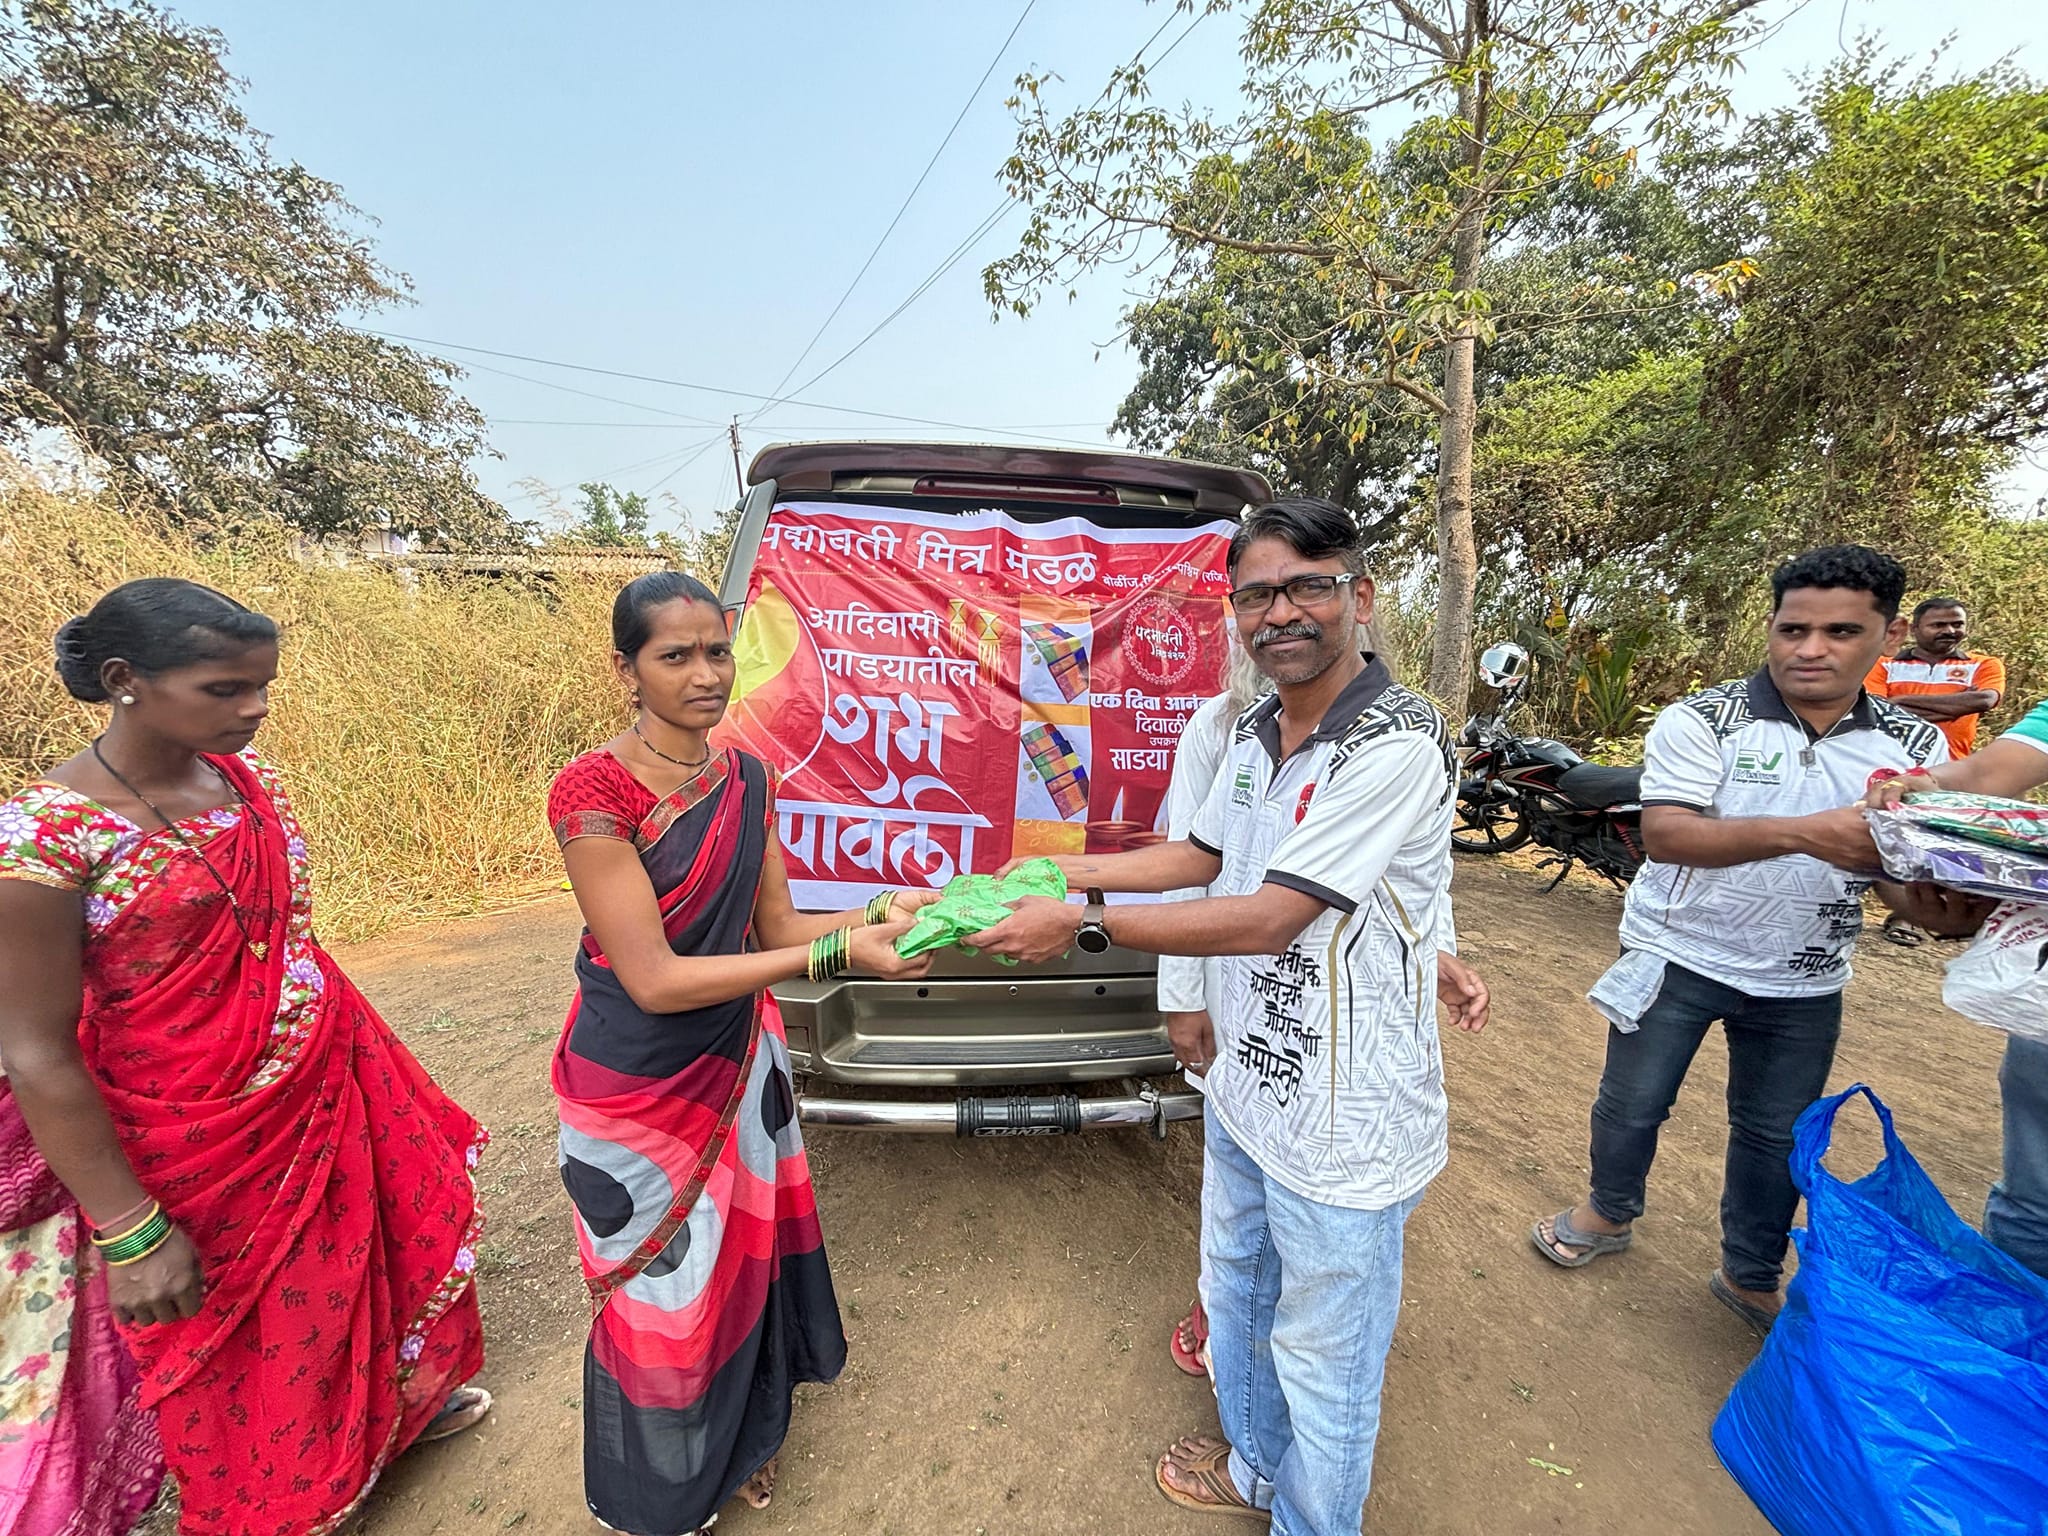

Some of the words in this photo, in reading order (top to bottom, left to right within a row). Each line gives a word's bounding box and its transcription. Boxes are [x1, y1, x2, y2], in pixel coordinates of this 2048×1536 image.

[916, 531, 992, 574] मित्र
[1005, 543, 1097, 585] मंडळ
[806, 601, 944, 640] आदिवासी
[1090, 693, 1122, 708] एक
[1124, 688, 1161, 711] दिवा
[822, 692, 961, 804] शुभ
[775, 775, 994, 888] पावली
